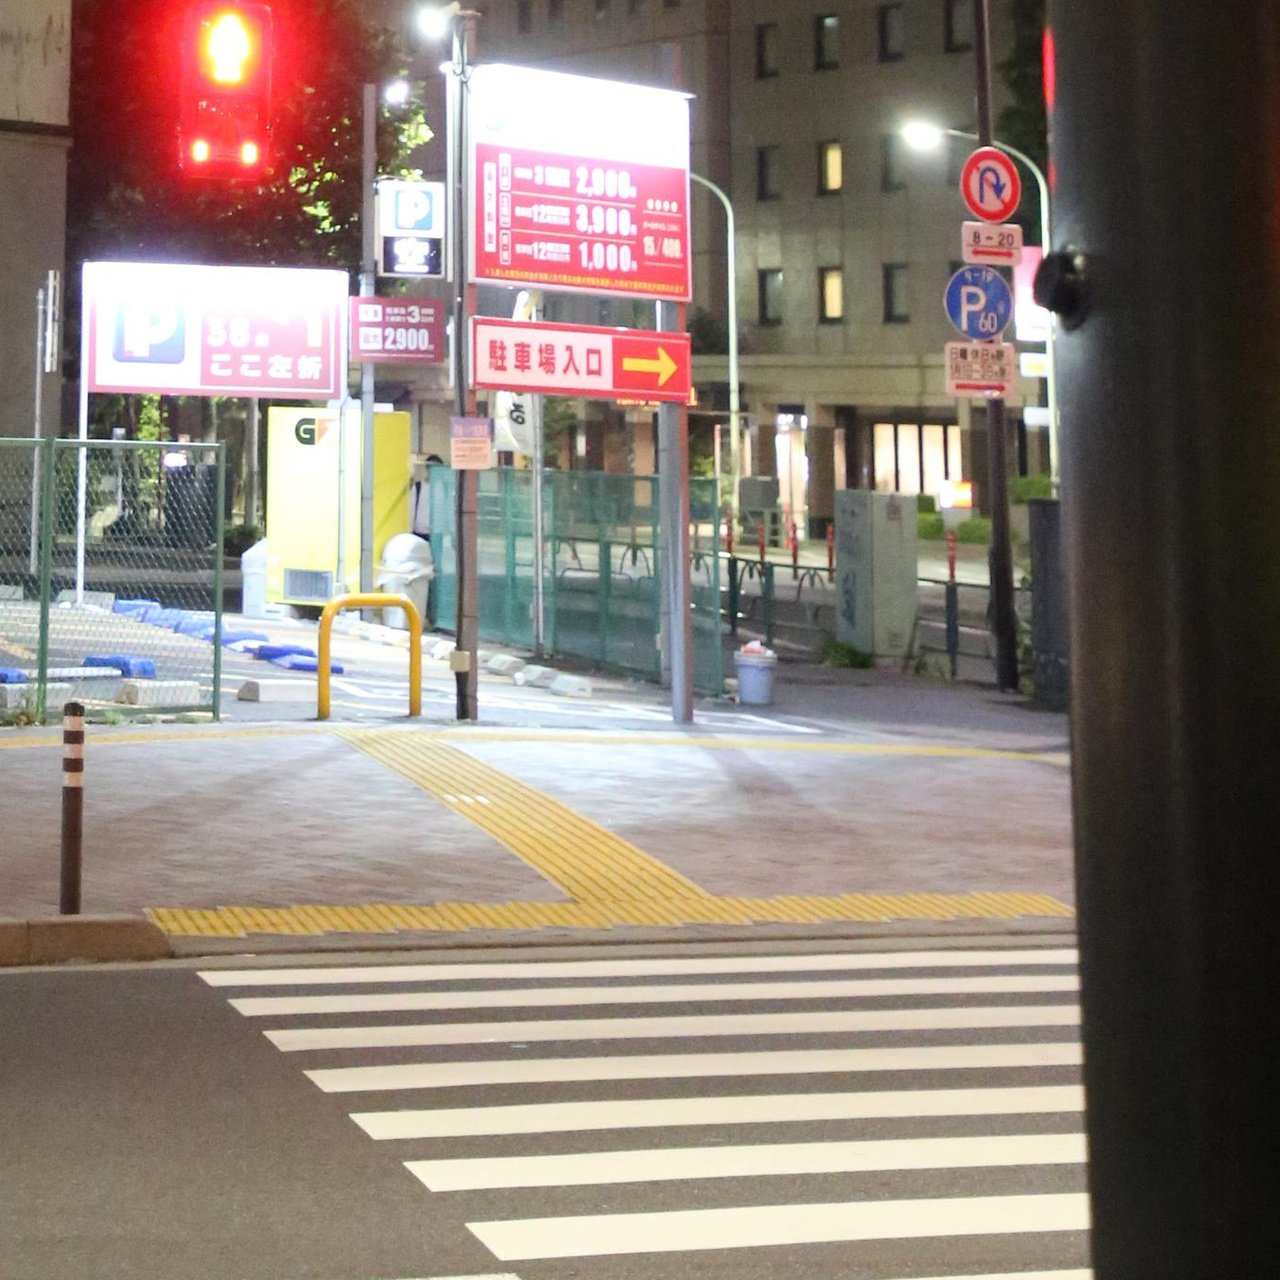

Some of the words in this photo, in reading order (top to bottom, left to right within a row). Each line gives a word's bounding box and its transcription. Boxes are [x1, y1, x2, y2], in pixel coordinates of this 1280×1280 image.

[960, 285, 987, 332] P
[978, 311, 998, 333] 60
[210, 353, 322, 380] ここ左折
[488, 338, 603, 378] 駐車場入口
